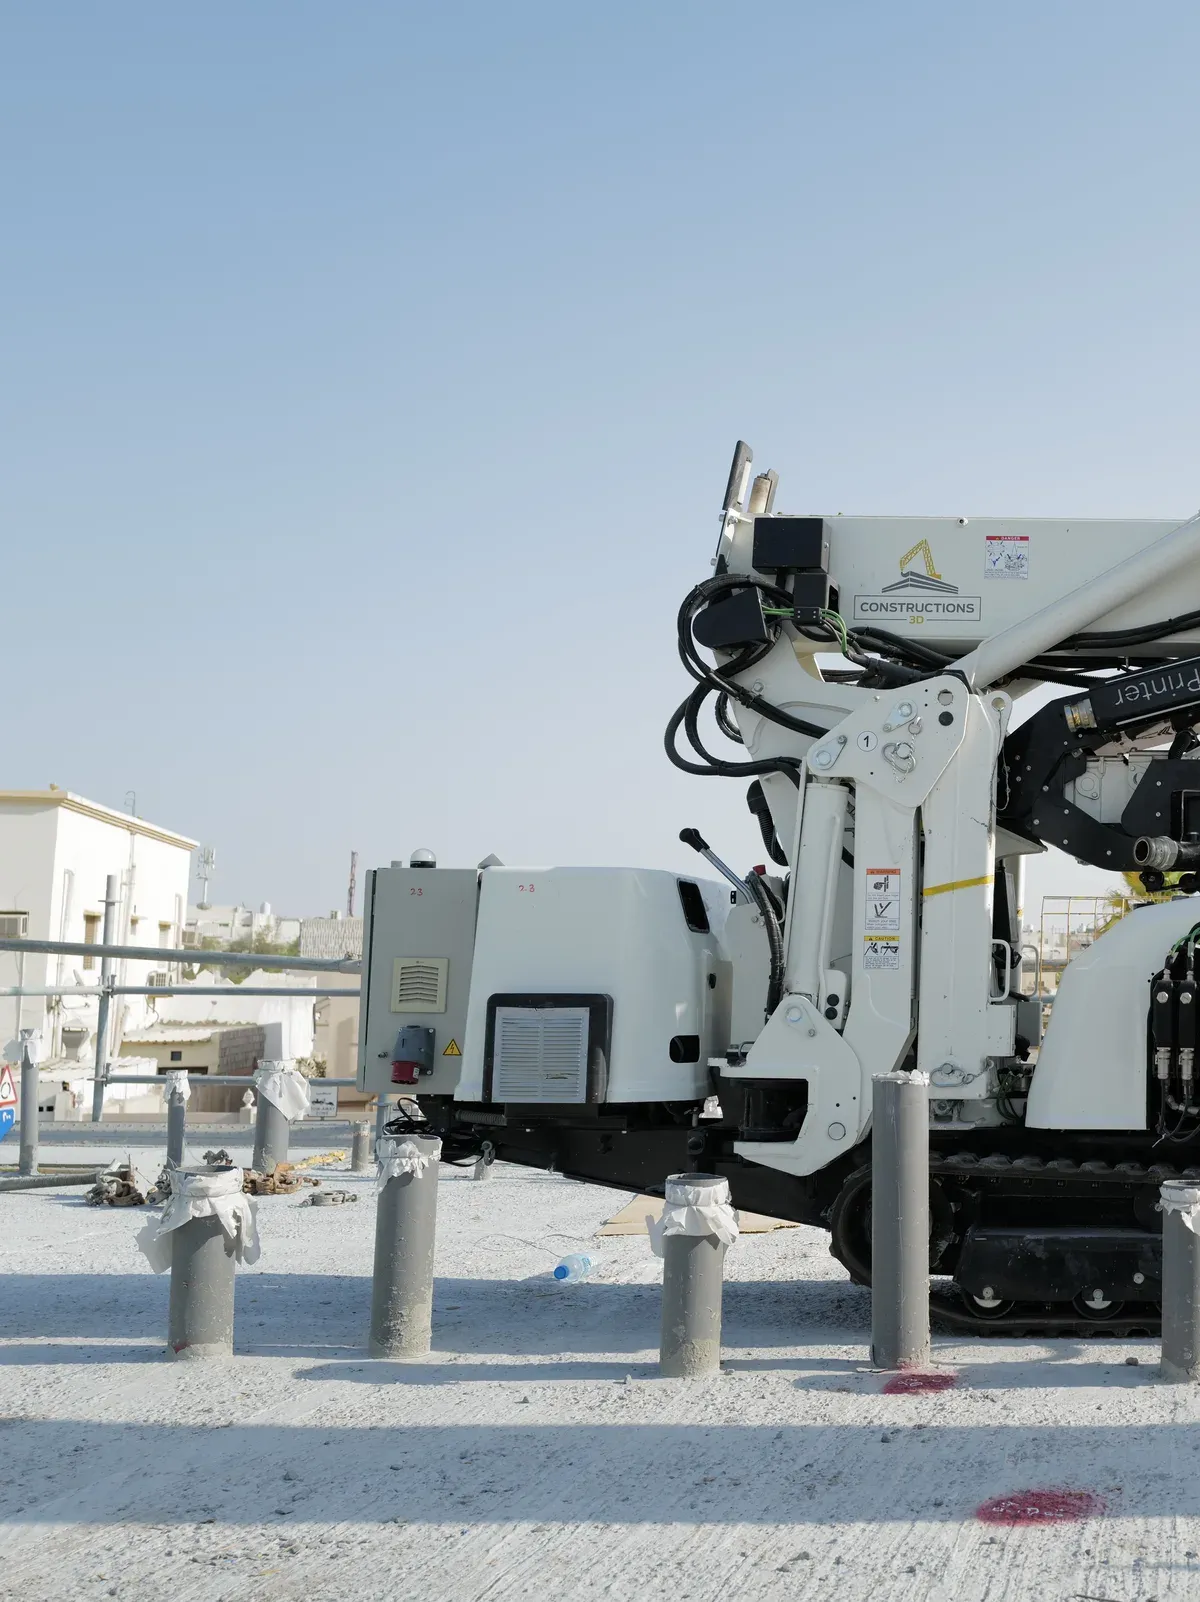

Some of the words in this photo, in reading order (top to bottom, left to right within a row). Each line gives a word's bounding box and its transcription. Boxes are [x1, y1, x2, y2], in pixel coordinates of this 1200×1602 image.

[860, 602, 975, 613] CONSTRUCTIONS
[909, 616, 924, 624] 3D
[863, 736, 870, 747] 1
